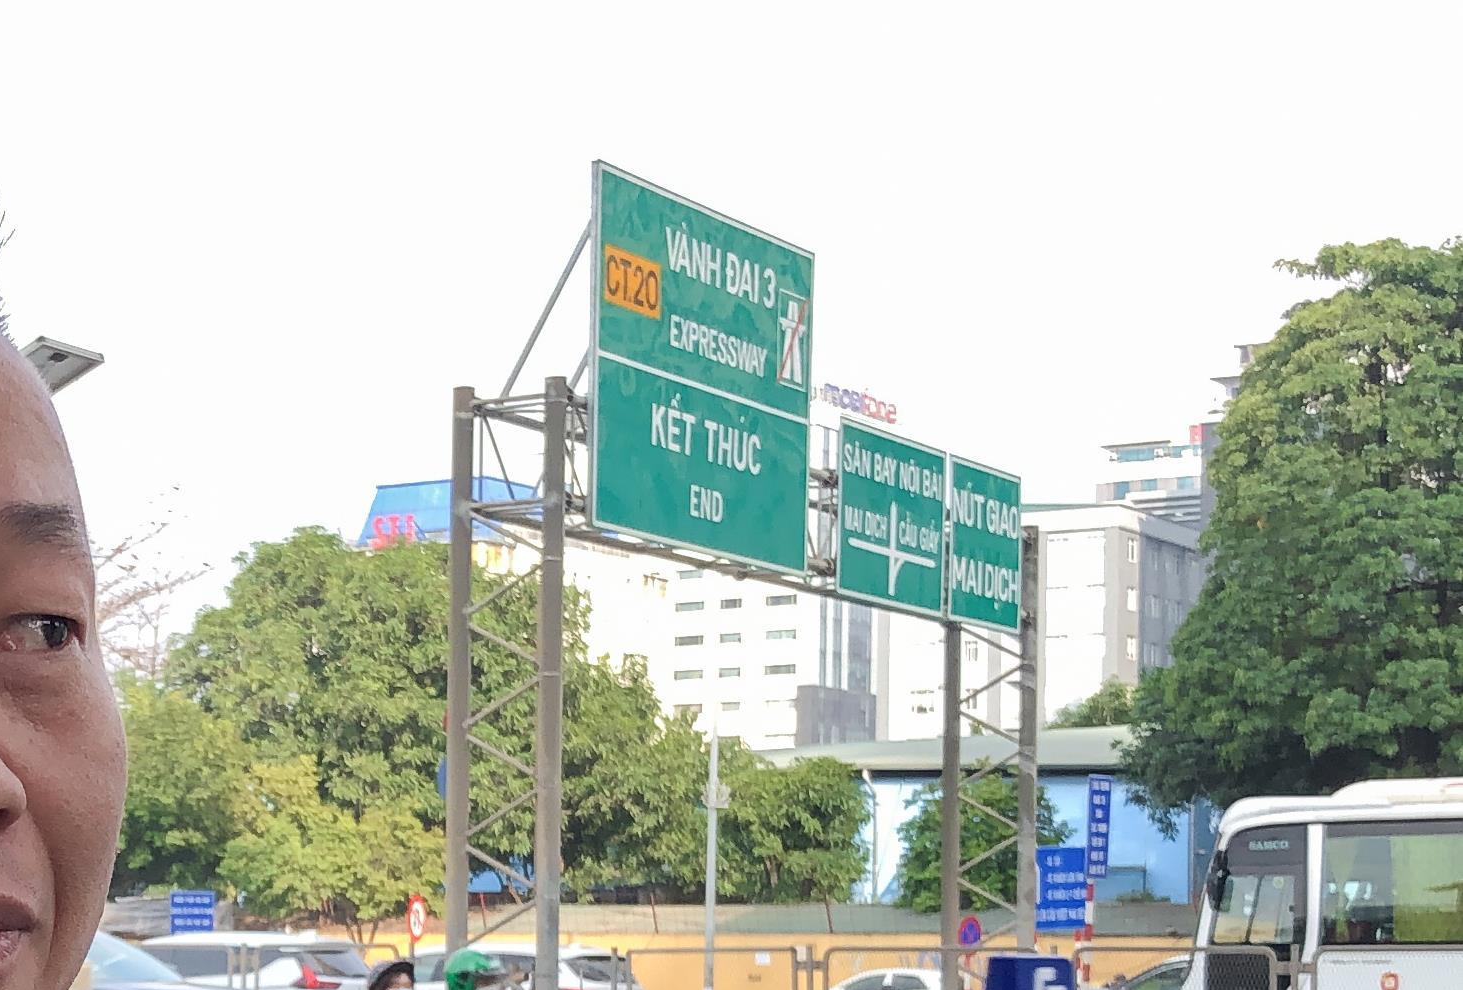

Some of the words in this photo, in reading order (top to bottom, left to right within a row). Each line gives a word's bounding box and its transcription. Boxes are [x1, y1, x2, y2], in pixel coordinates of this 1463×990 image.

[666, 222, 722, 288] VÀNH
[726, 251, 759, 304] ĐAI
[763, 268, 776, 309] 3
[669, 314, 767, 377] EXPRESSWAY
[651, 392, 696, 457] KẾT
[704, 415, 761, 476] THÚC
[843, 441, 872, 480] SÂN
[874, 452, 897, 486] BAY
[690, 484, 724, 523] END
[953, 482, 985, 530] NÚT
[986, 498, 1018, 540] GIAO
[952, 554, 984, 597] MAI
[984, 562, 1018, 610] DỊCH
